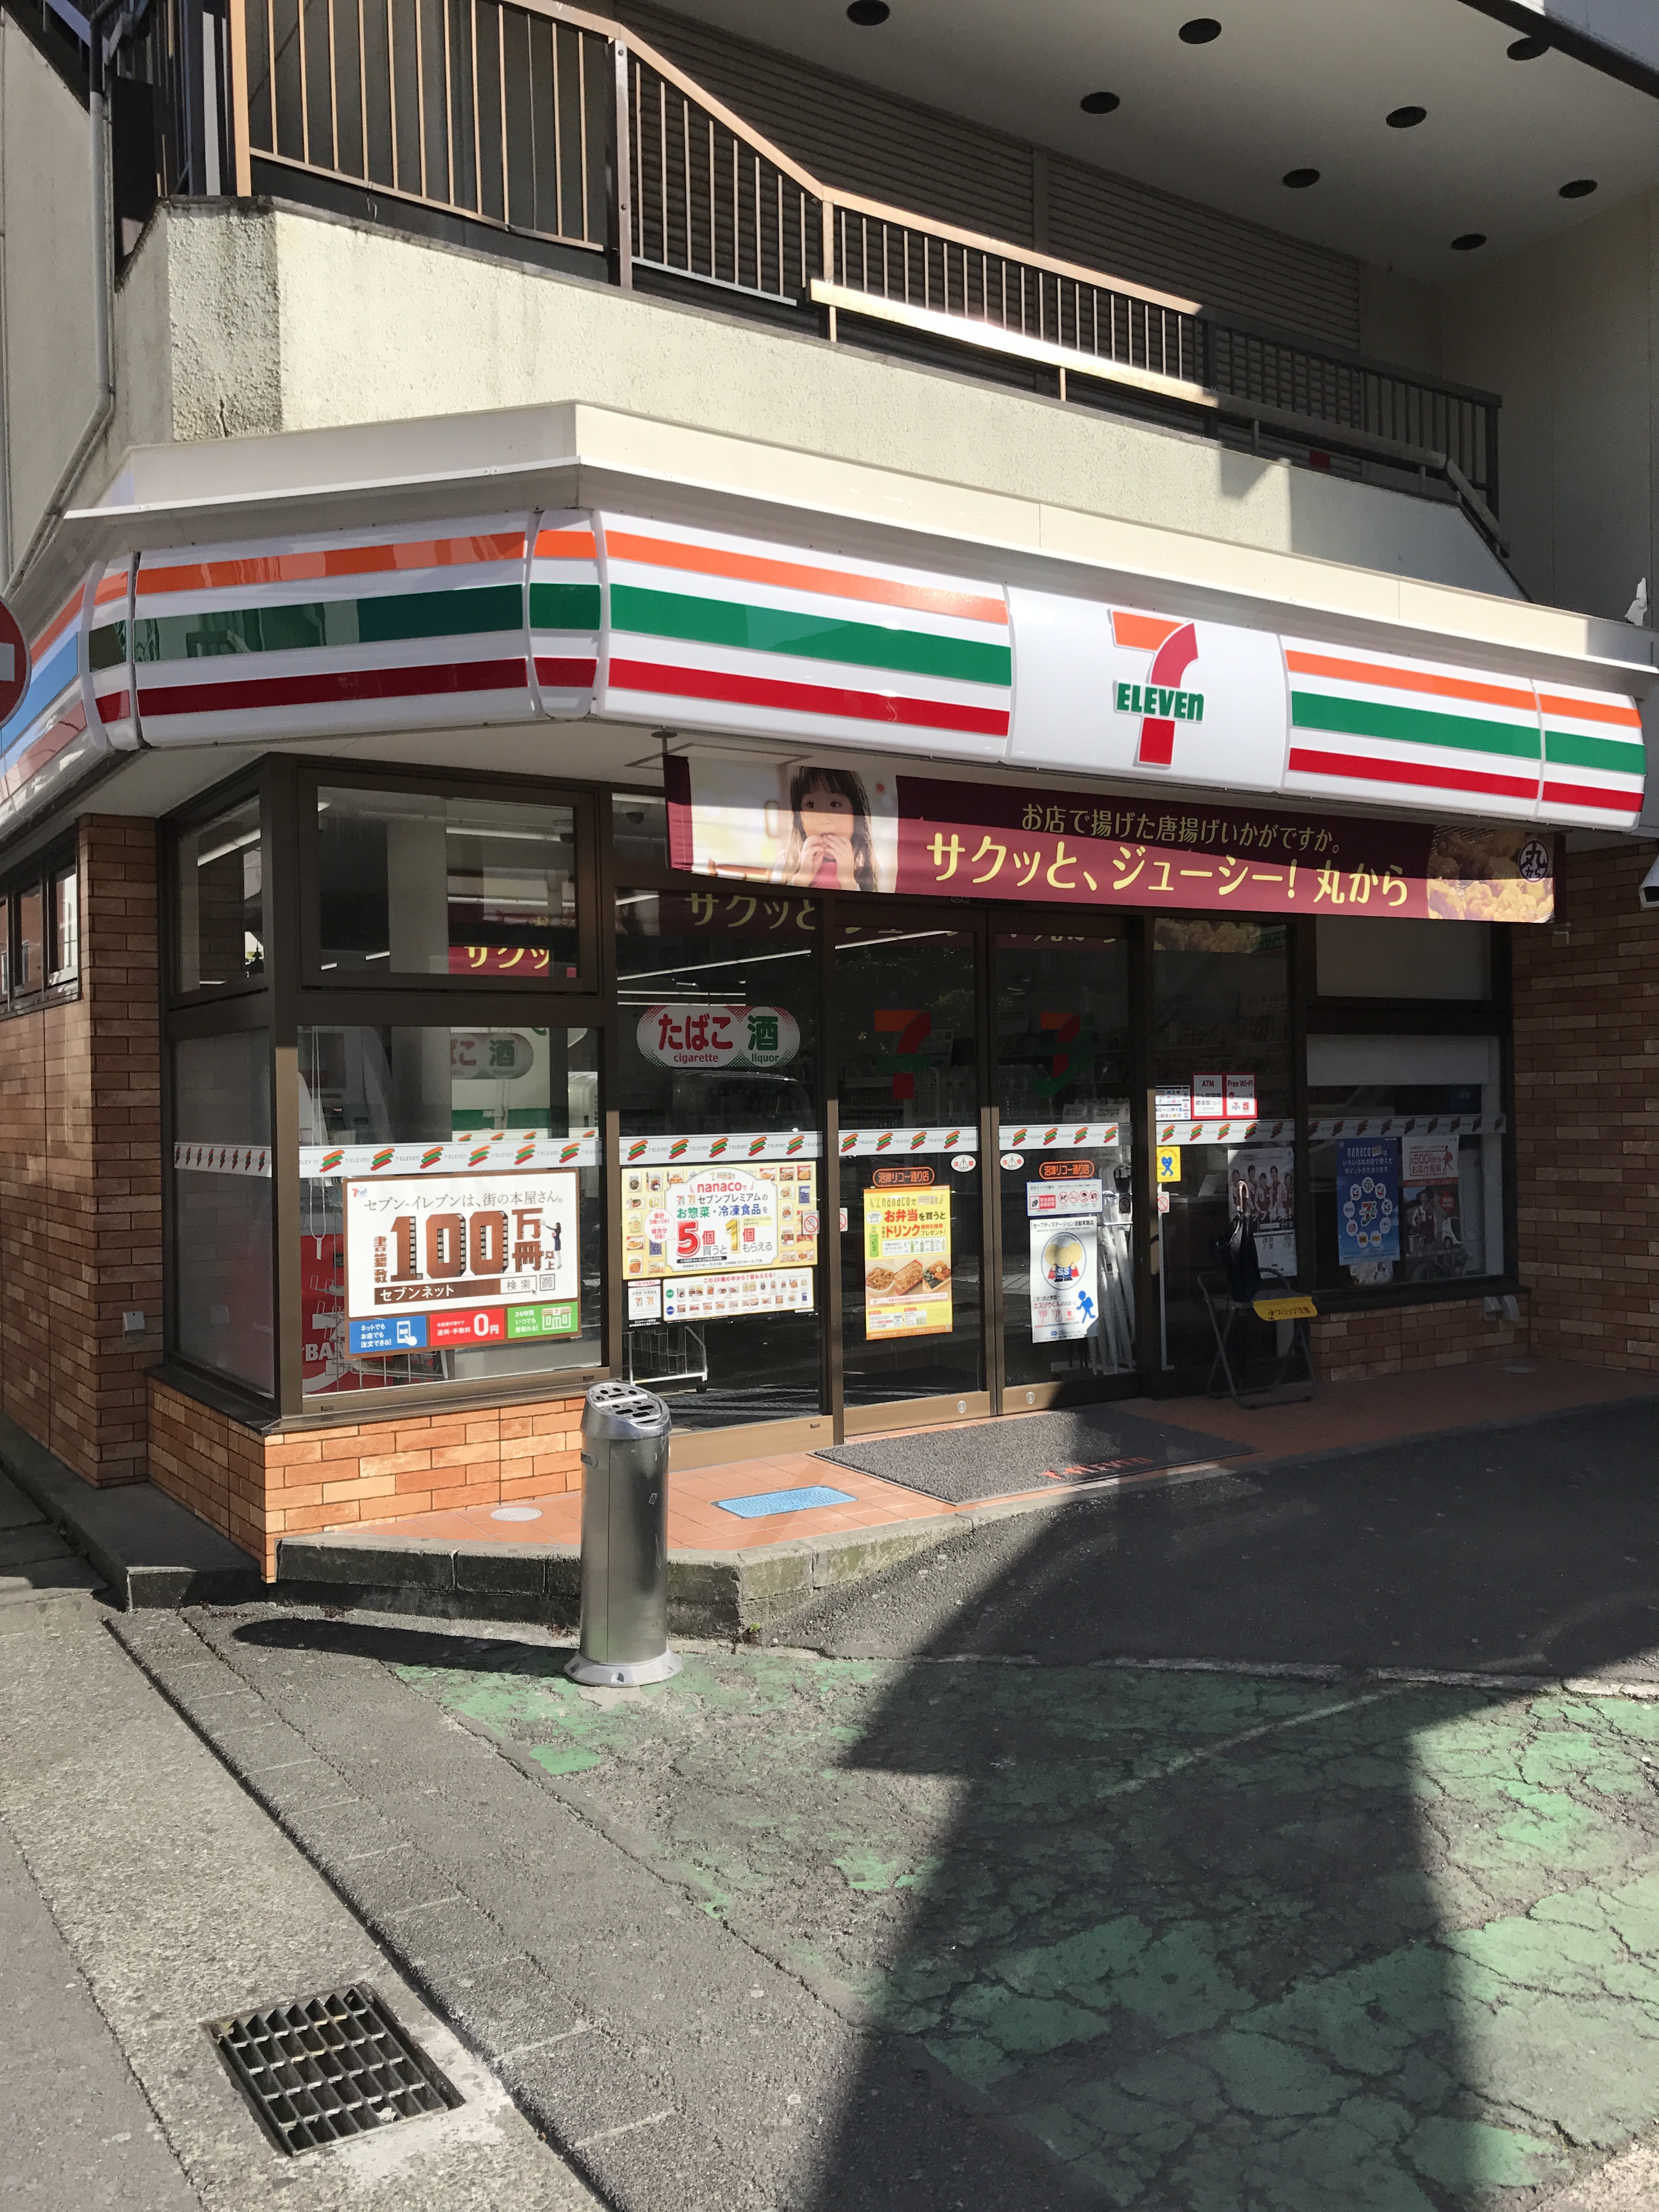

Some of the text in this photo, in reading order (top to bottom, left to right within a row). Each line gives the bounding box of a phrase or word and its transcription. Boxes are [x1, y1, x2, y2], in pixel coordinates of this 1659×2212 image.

[1022, 804, 1340, 854] お店で揚げた唐揚げいかがですか。
[658, 1013, 778, 1051] たばこ 酒
[674, 1053, 780, 1064] cigarette liquor
[364, 1190, 563, 1212] セブン-イレブンは、街の本屋さん。
[884, 1208, 946, 1222] お弁当を買うと
[886, 1223, 920, 1239] ドリンク
[390, 1210, 509, 1282] 100
[1057, 1267, 1070, 1276] SS
[380, 1285, 454, 1302] セブンネット
